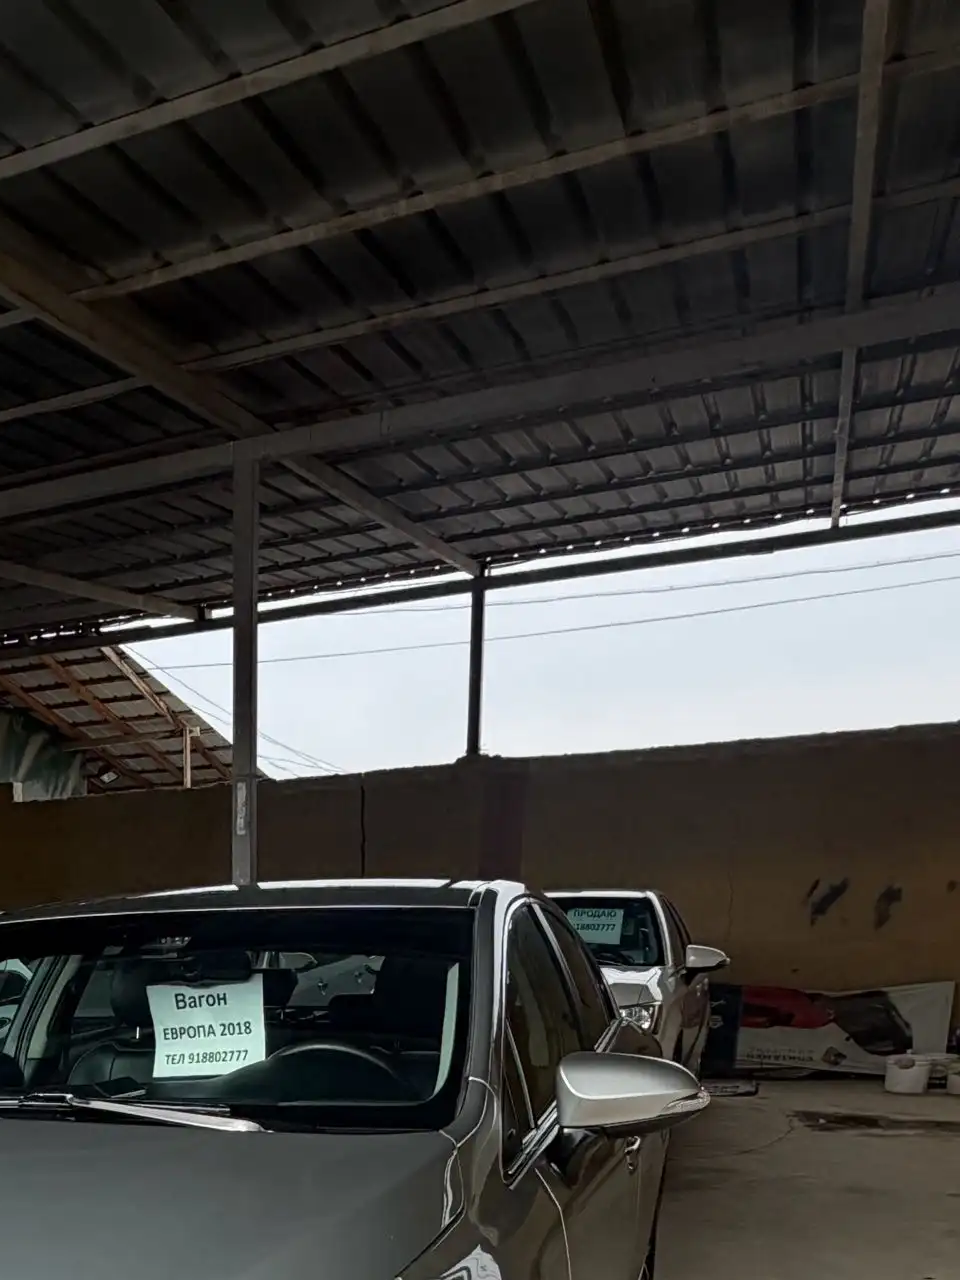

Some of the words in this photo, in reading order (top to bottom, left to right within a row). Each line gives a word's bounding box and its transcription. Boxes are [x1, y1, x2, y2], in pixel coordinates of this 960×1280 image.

[573, 909, 617, 918] ПРОДАЮ
[573, 923, 617, 932] 18802777
[174, 992, 228, 1010] Вагон
[163, 1024, 217, 1041] ЕВРОПА
[219, 1020, 253, 1037] 2018
[164, 1053, 185, 1065] ТЕЛ
[188, 1049, 249, 1064] 918802777
